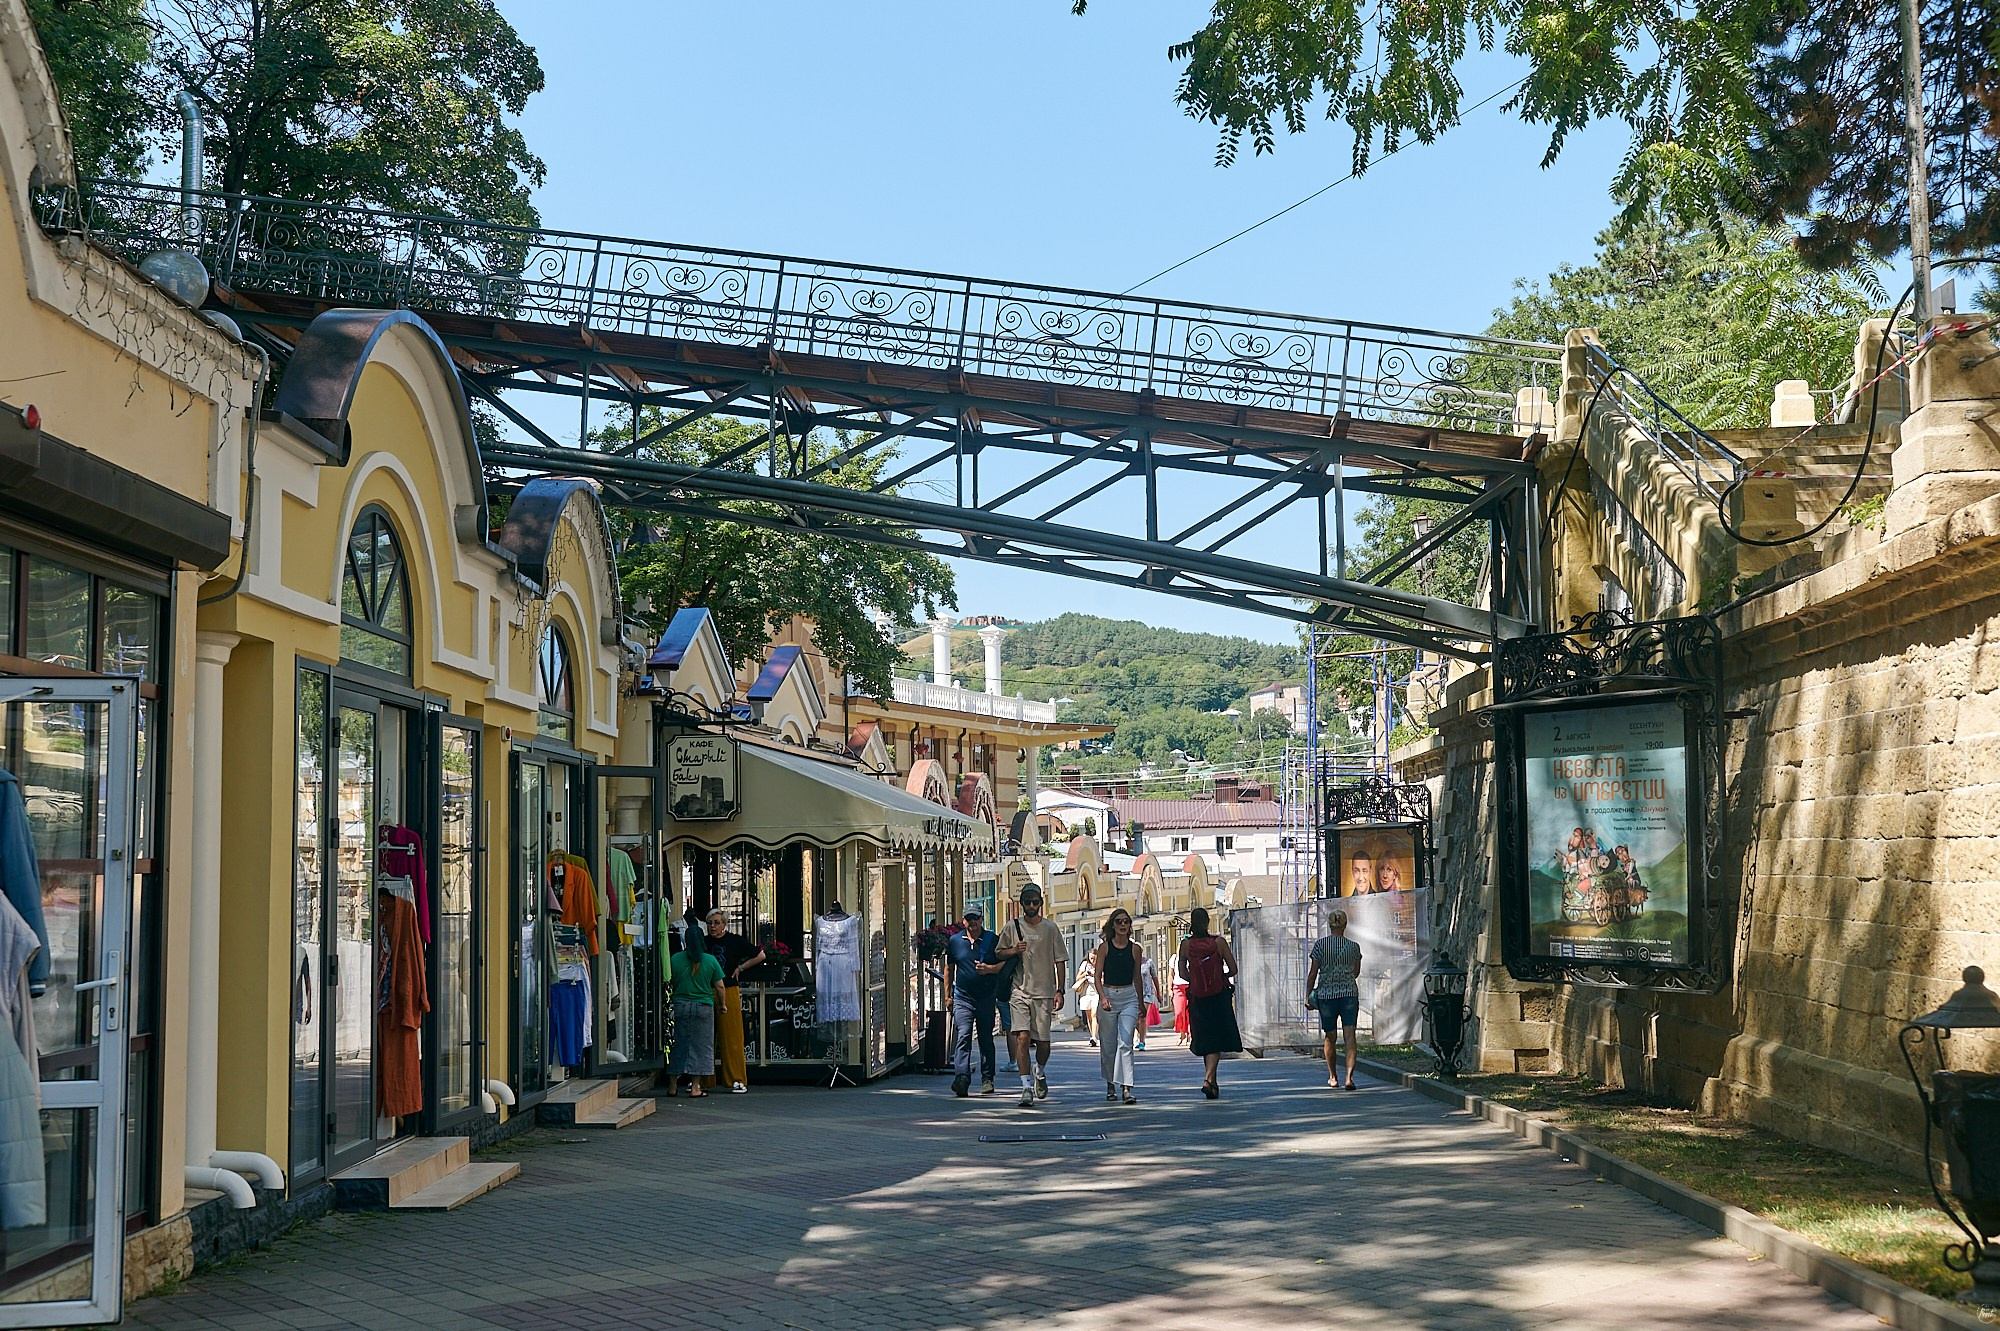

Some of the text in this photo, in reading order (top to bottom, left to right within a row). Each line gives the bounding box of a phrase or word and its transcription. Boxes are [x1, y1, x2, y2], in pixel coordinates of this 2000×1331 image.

[1629, 721, 1664, 730] ЕССЕНТУКИ
[1553, 726, 1591, 741] 2 АВГУСТА
[1552, 743, 1624, 755] Музыкальная комедия
[1645, 741, 1664, 749] 19:00
[676, 746, 727, 766] Старый
[672, 767, 700, 784] Баку
[1553, 757, 1626, 779] НЕВЕСТА
[1573, 779, 1665, 802] ИМЕРЕТИИ
[1591, 807, 1635, 817] продолжение
[1343, 837, 1352, 849] 30
[775, 997, 817, 1019] Стар
